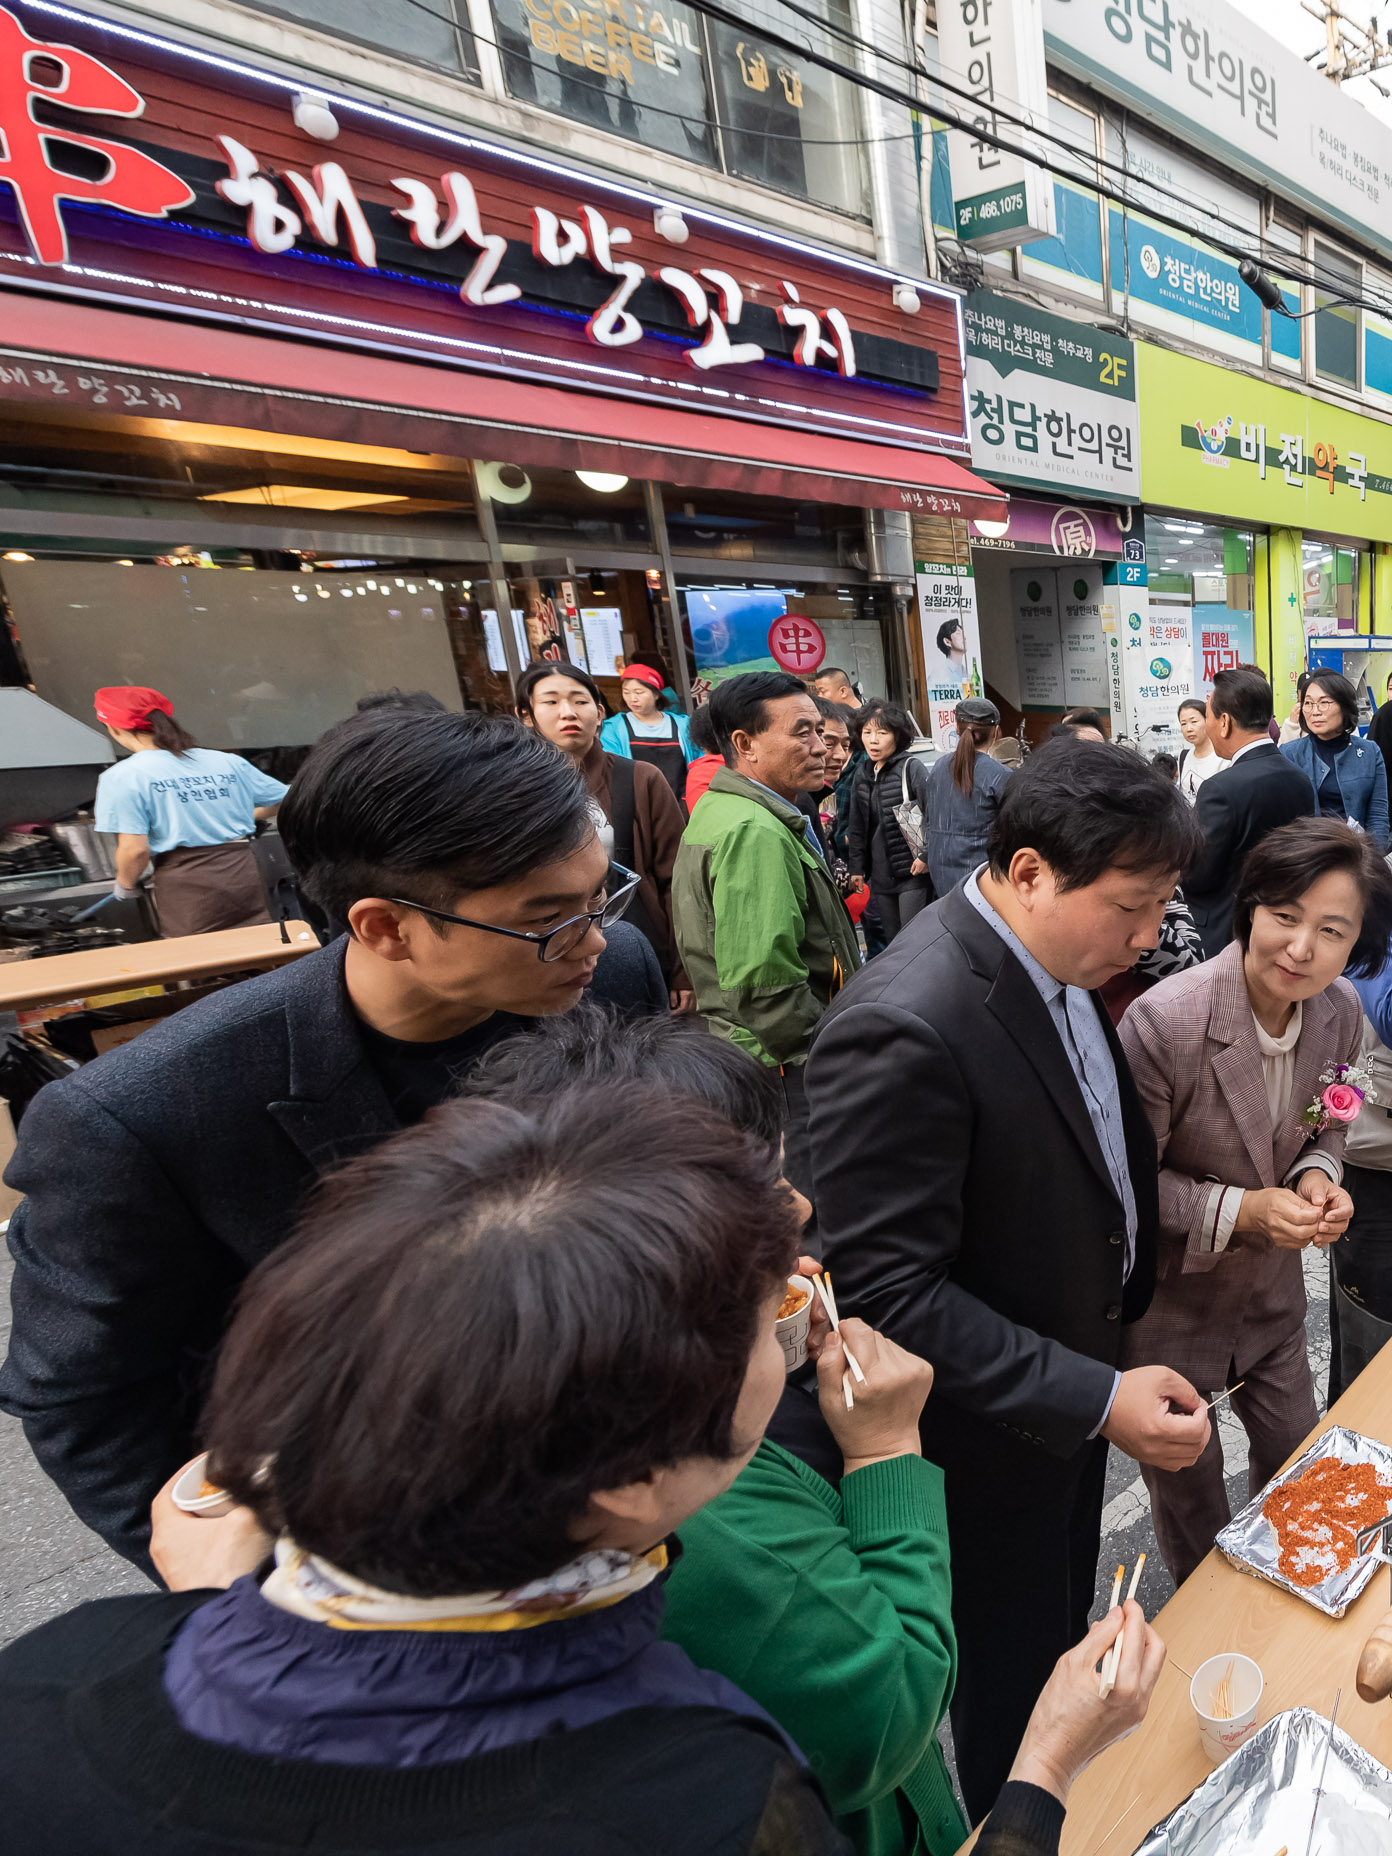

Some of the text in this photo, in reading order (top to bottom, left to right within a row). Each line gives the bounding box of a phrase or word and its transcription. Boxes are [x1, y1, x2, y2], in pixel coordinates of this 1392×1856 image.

[529, 19, 634, 85] BEER
[959, 193, 1024, 227] 2F 466.1075
[1163, 253, 1241, 314] 청담한의원
[1158, 287, 1231, 321] ORIENTAL MEDICAL CENTER
[964, 308, 1094, 364] 추나요법 봉침요법 척추교정
[964, 327, 1055, 369] 목/허리 디스크 전문
[1099, 352, 1128, 387] 2F
[969, 388, 1134, 473] 청담한의원
[994, 451, 1115, 483] ORIENTAL MEDICAL CENTER
[1201, 453, 1231, 468] PHARMACY
[1239, 422, 1368, 502] 비전약국
[1129, 549, 1140, 561] 73
[933, 584, 963, 597] 이 맛이
[1125, 567, 1141, 582] 2F
[778, 621, 818, 667] 串
[1164, 626, 1188, 640] 상담이
[931, 689, 962, 702] TERRA
[1110, 651, 1122, 713] 청담한의원
[1138, 683, 1190, 699] 청담한의원
[937, 710, 950, 729] 진로
[150, 778, 180, 793] 건대
